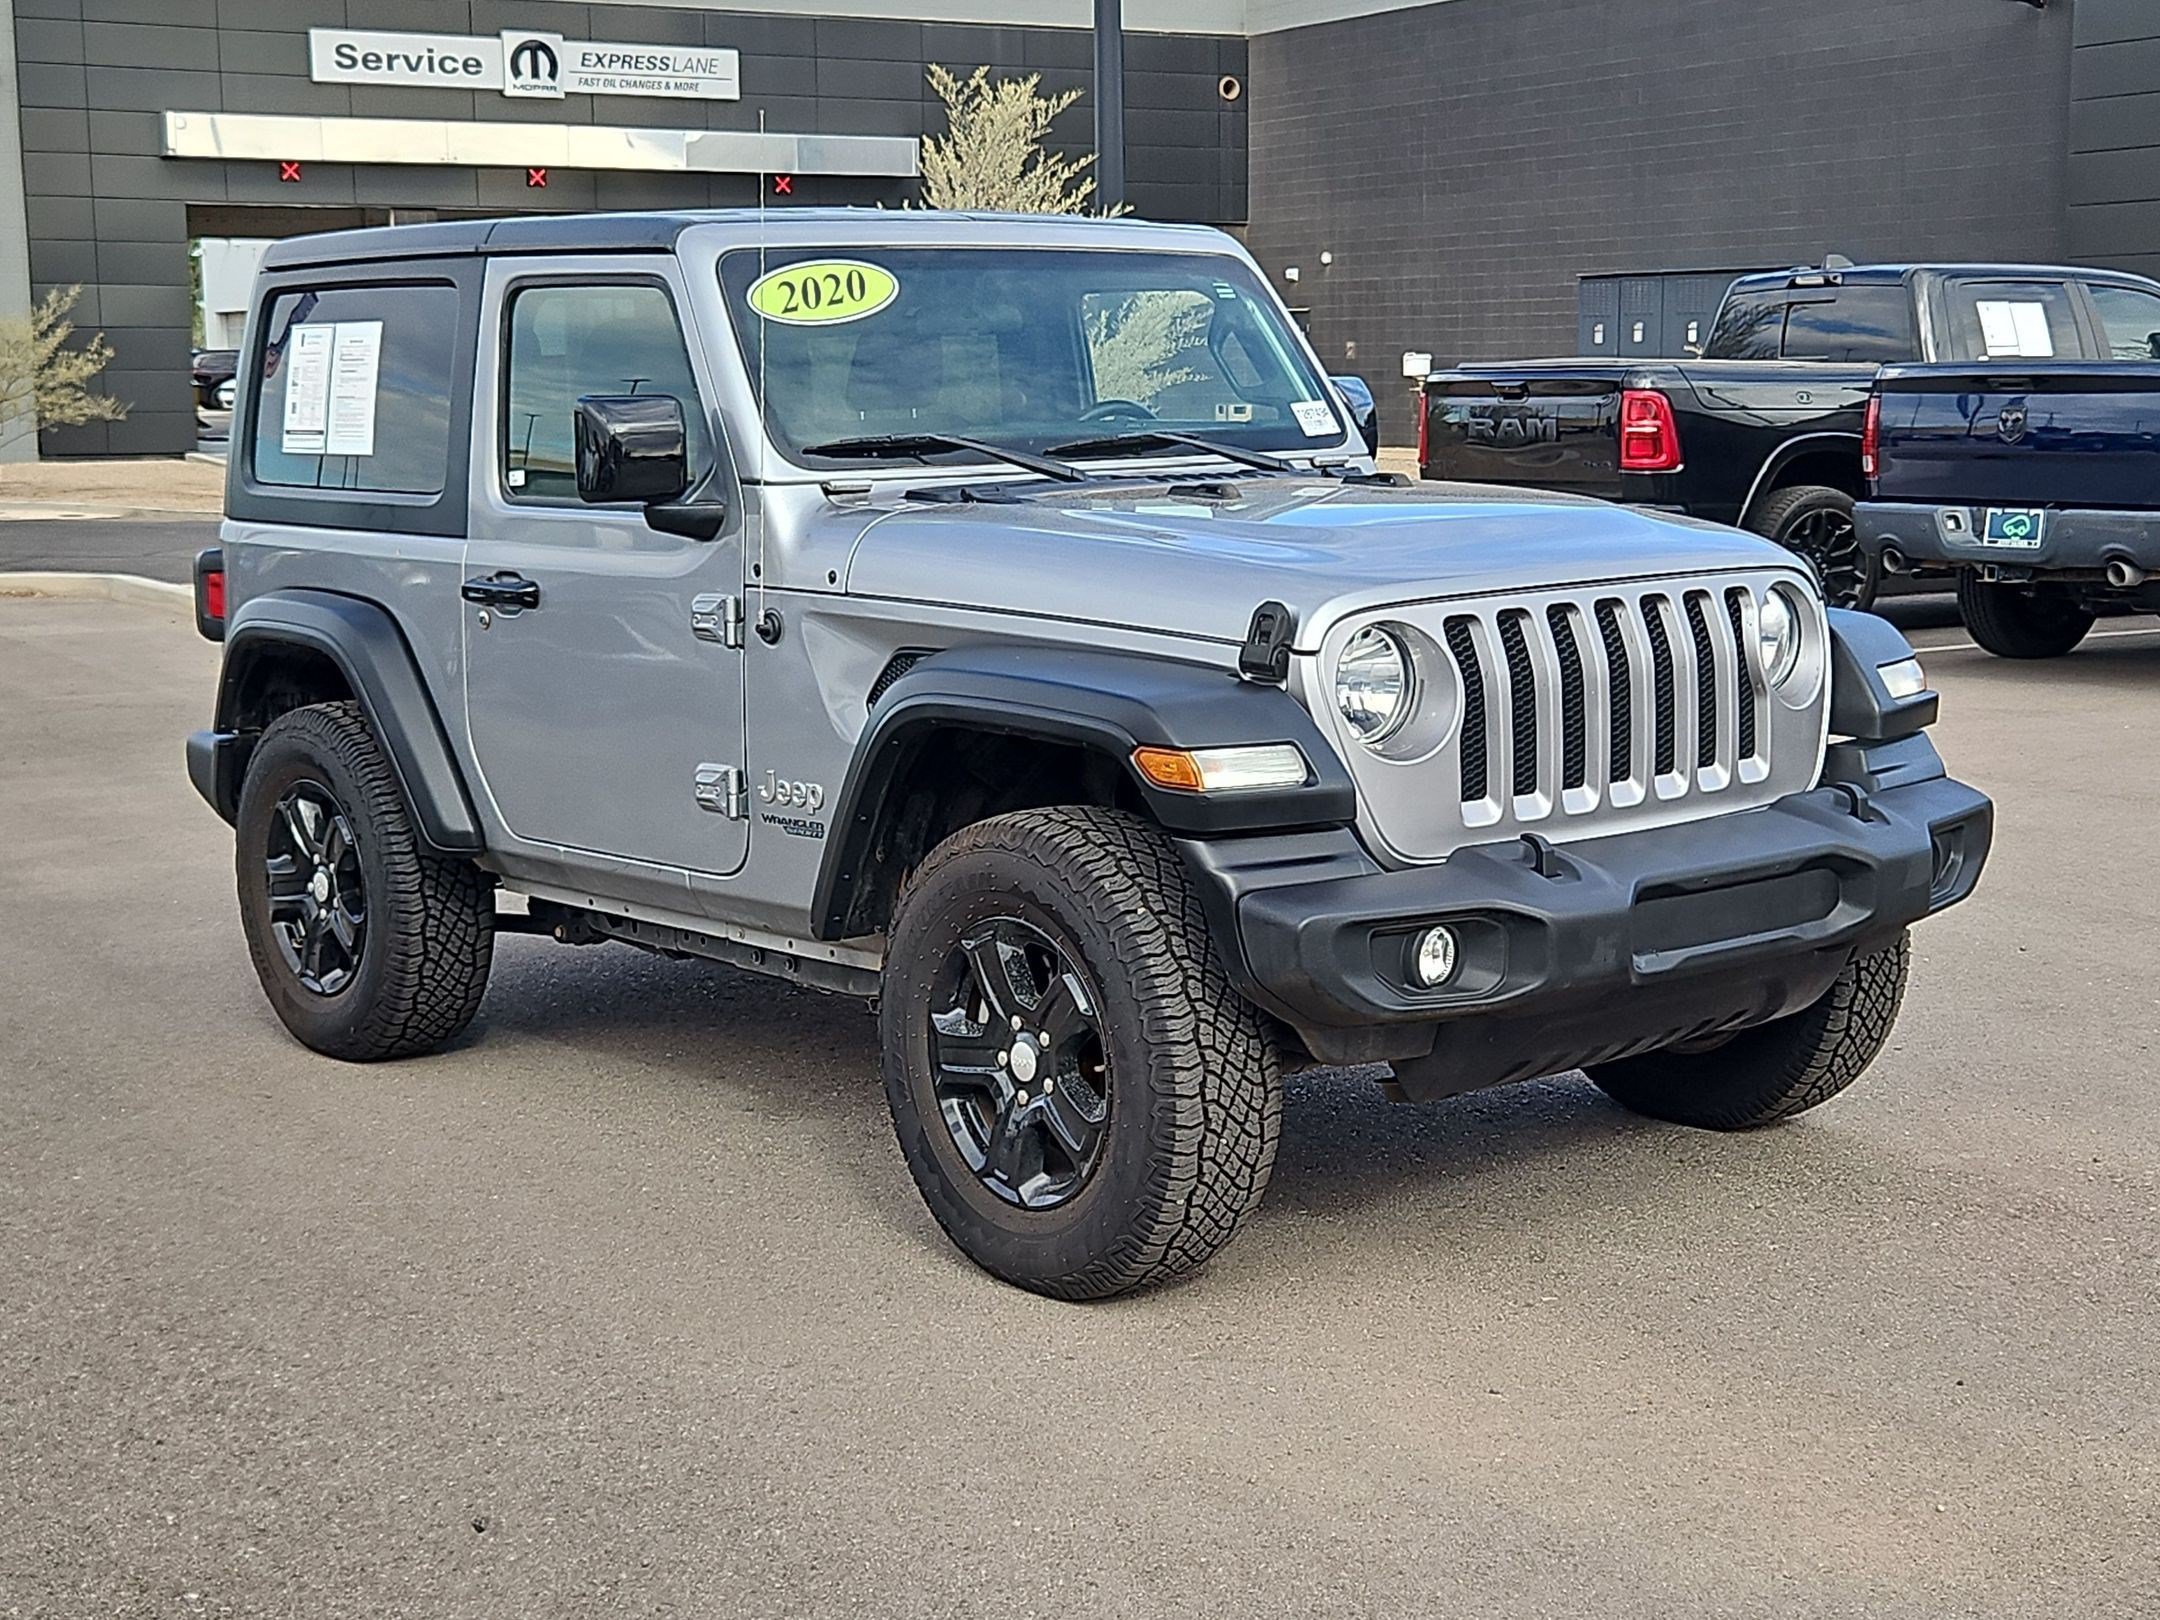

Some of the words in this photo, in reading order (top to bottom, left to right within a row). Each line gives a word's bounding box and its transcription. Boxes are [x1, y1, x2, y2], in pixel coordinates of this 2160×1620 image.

[334, 43, 483, 76] Service
[512, 83, 558, 93] MOPAR
[577, 77, 601, 88] FAST
[603, 78, 618, 89] OIL
[619, 79, 663, 91] CHANGES
[664, 81, 672, 91] &
[673, 82, 700, 93] MORE
[777, 269, 866, 315] 2020
[1467, 416, 1559, 442] RAM
[757, 769, 824, 816] Jeep
